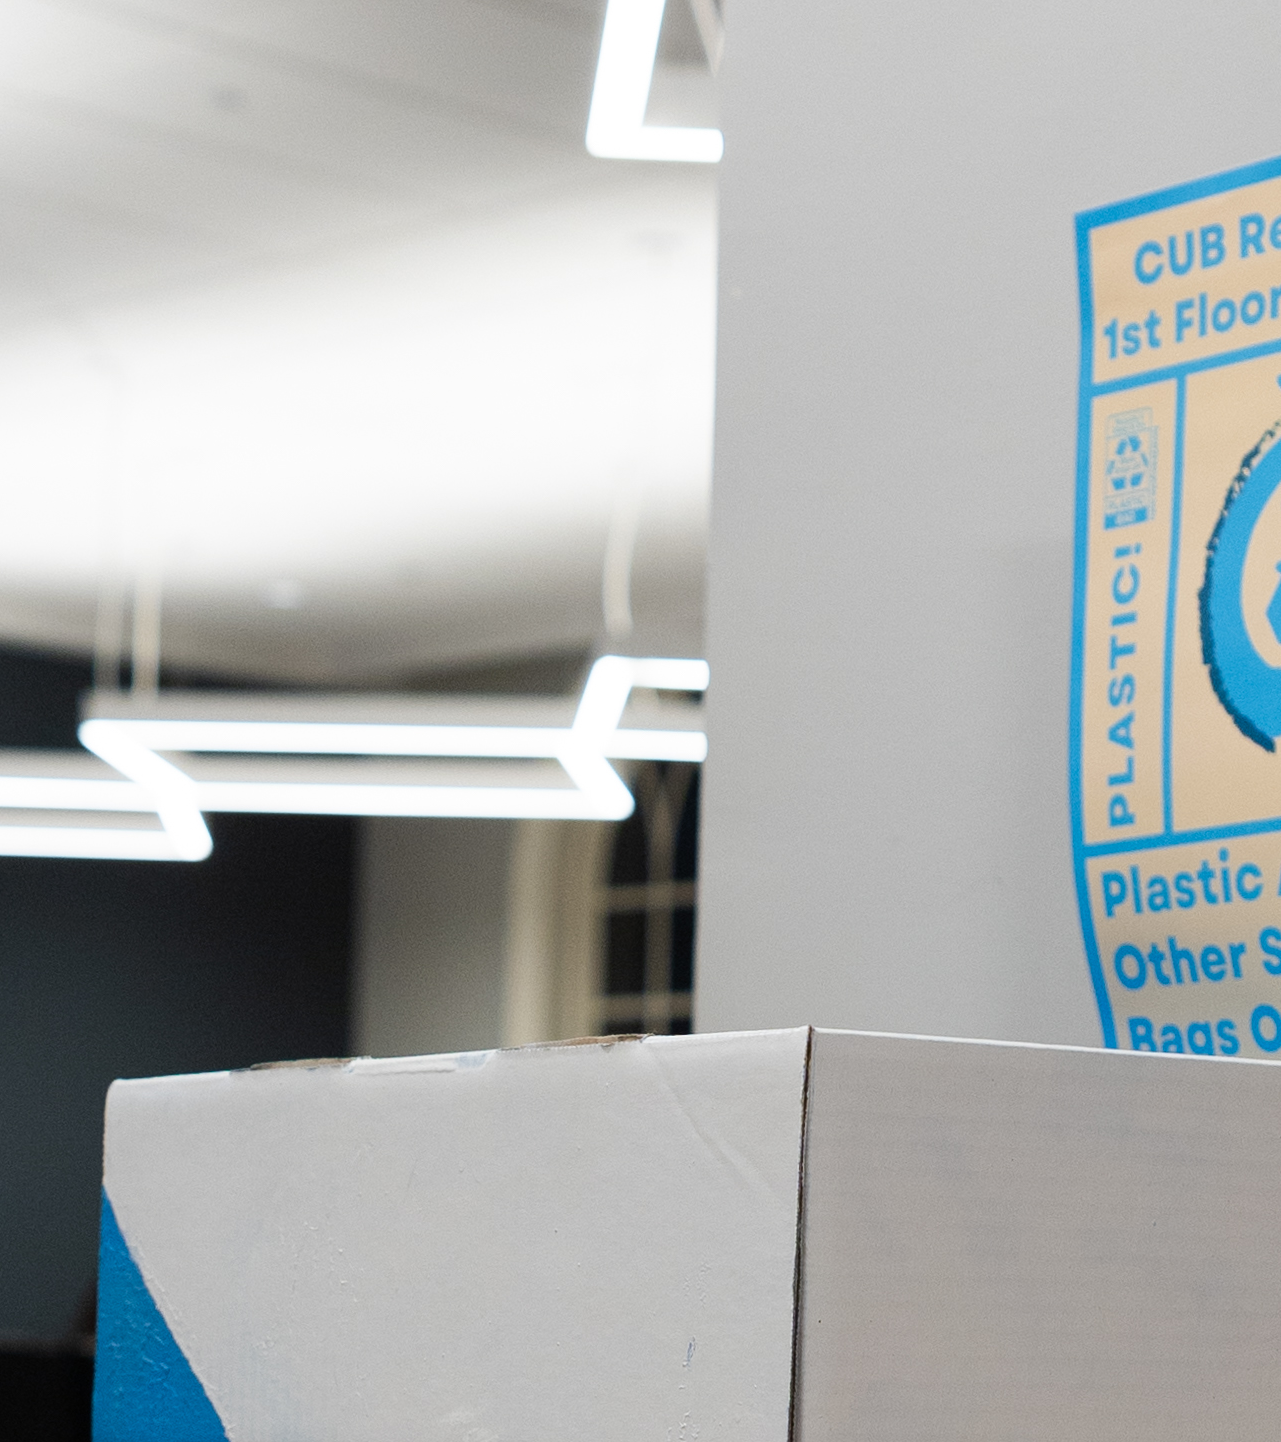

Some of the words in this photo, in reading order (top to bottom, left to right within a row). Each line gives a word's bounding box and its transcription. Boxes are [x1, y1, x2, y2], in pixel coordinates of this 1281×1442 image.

[1134, 228, 1227, 285] CUB
[1104, 311, 1161, 358] 1st
[1107, 542, 1143, 827] PLASTIC!
[1100, 849, 1262, 917] Plastic
[1114, 936, 1246, 990] Other
